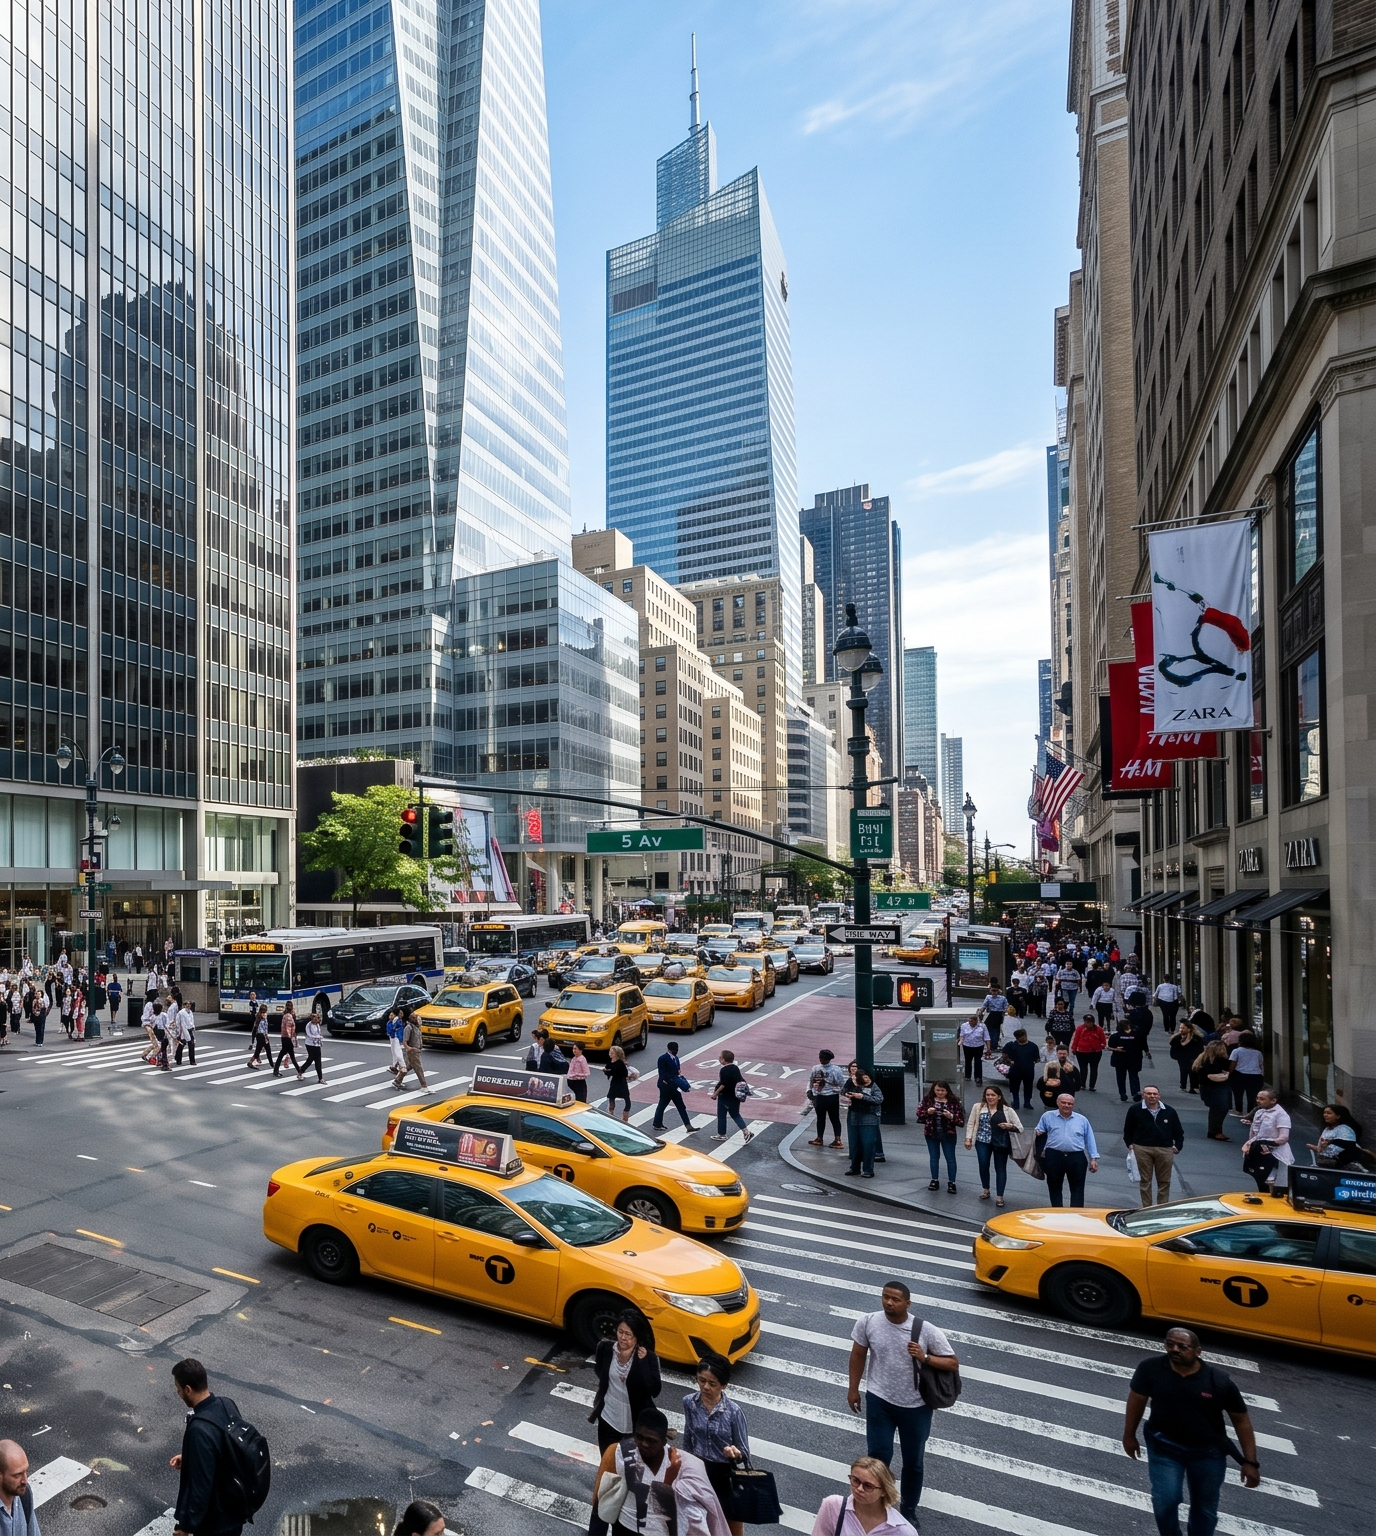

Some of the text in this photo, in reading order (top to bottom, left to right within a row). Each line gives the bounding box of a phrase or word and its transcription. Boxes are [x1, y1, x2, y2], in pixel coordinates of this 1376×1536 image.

[1172, 707, 1233, 721] ZARA
[1119, 758, 1163, 779] H&M
[622, 834, 662, 848] 5 Av
[869, 931, 891, 939] WAY
